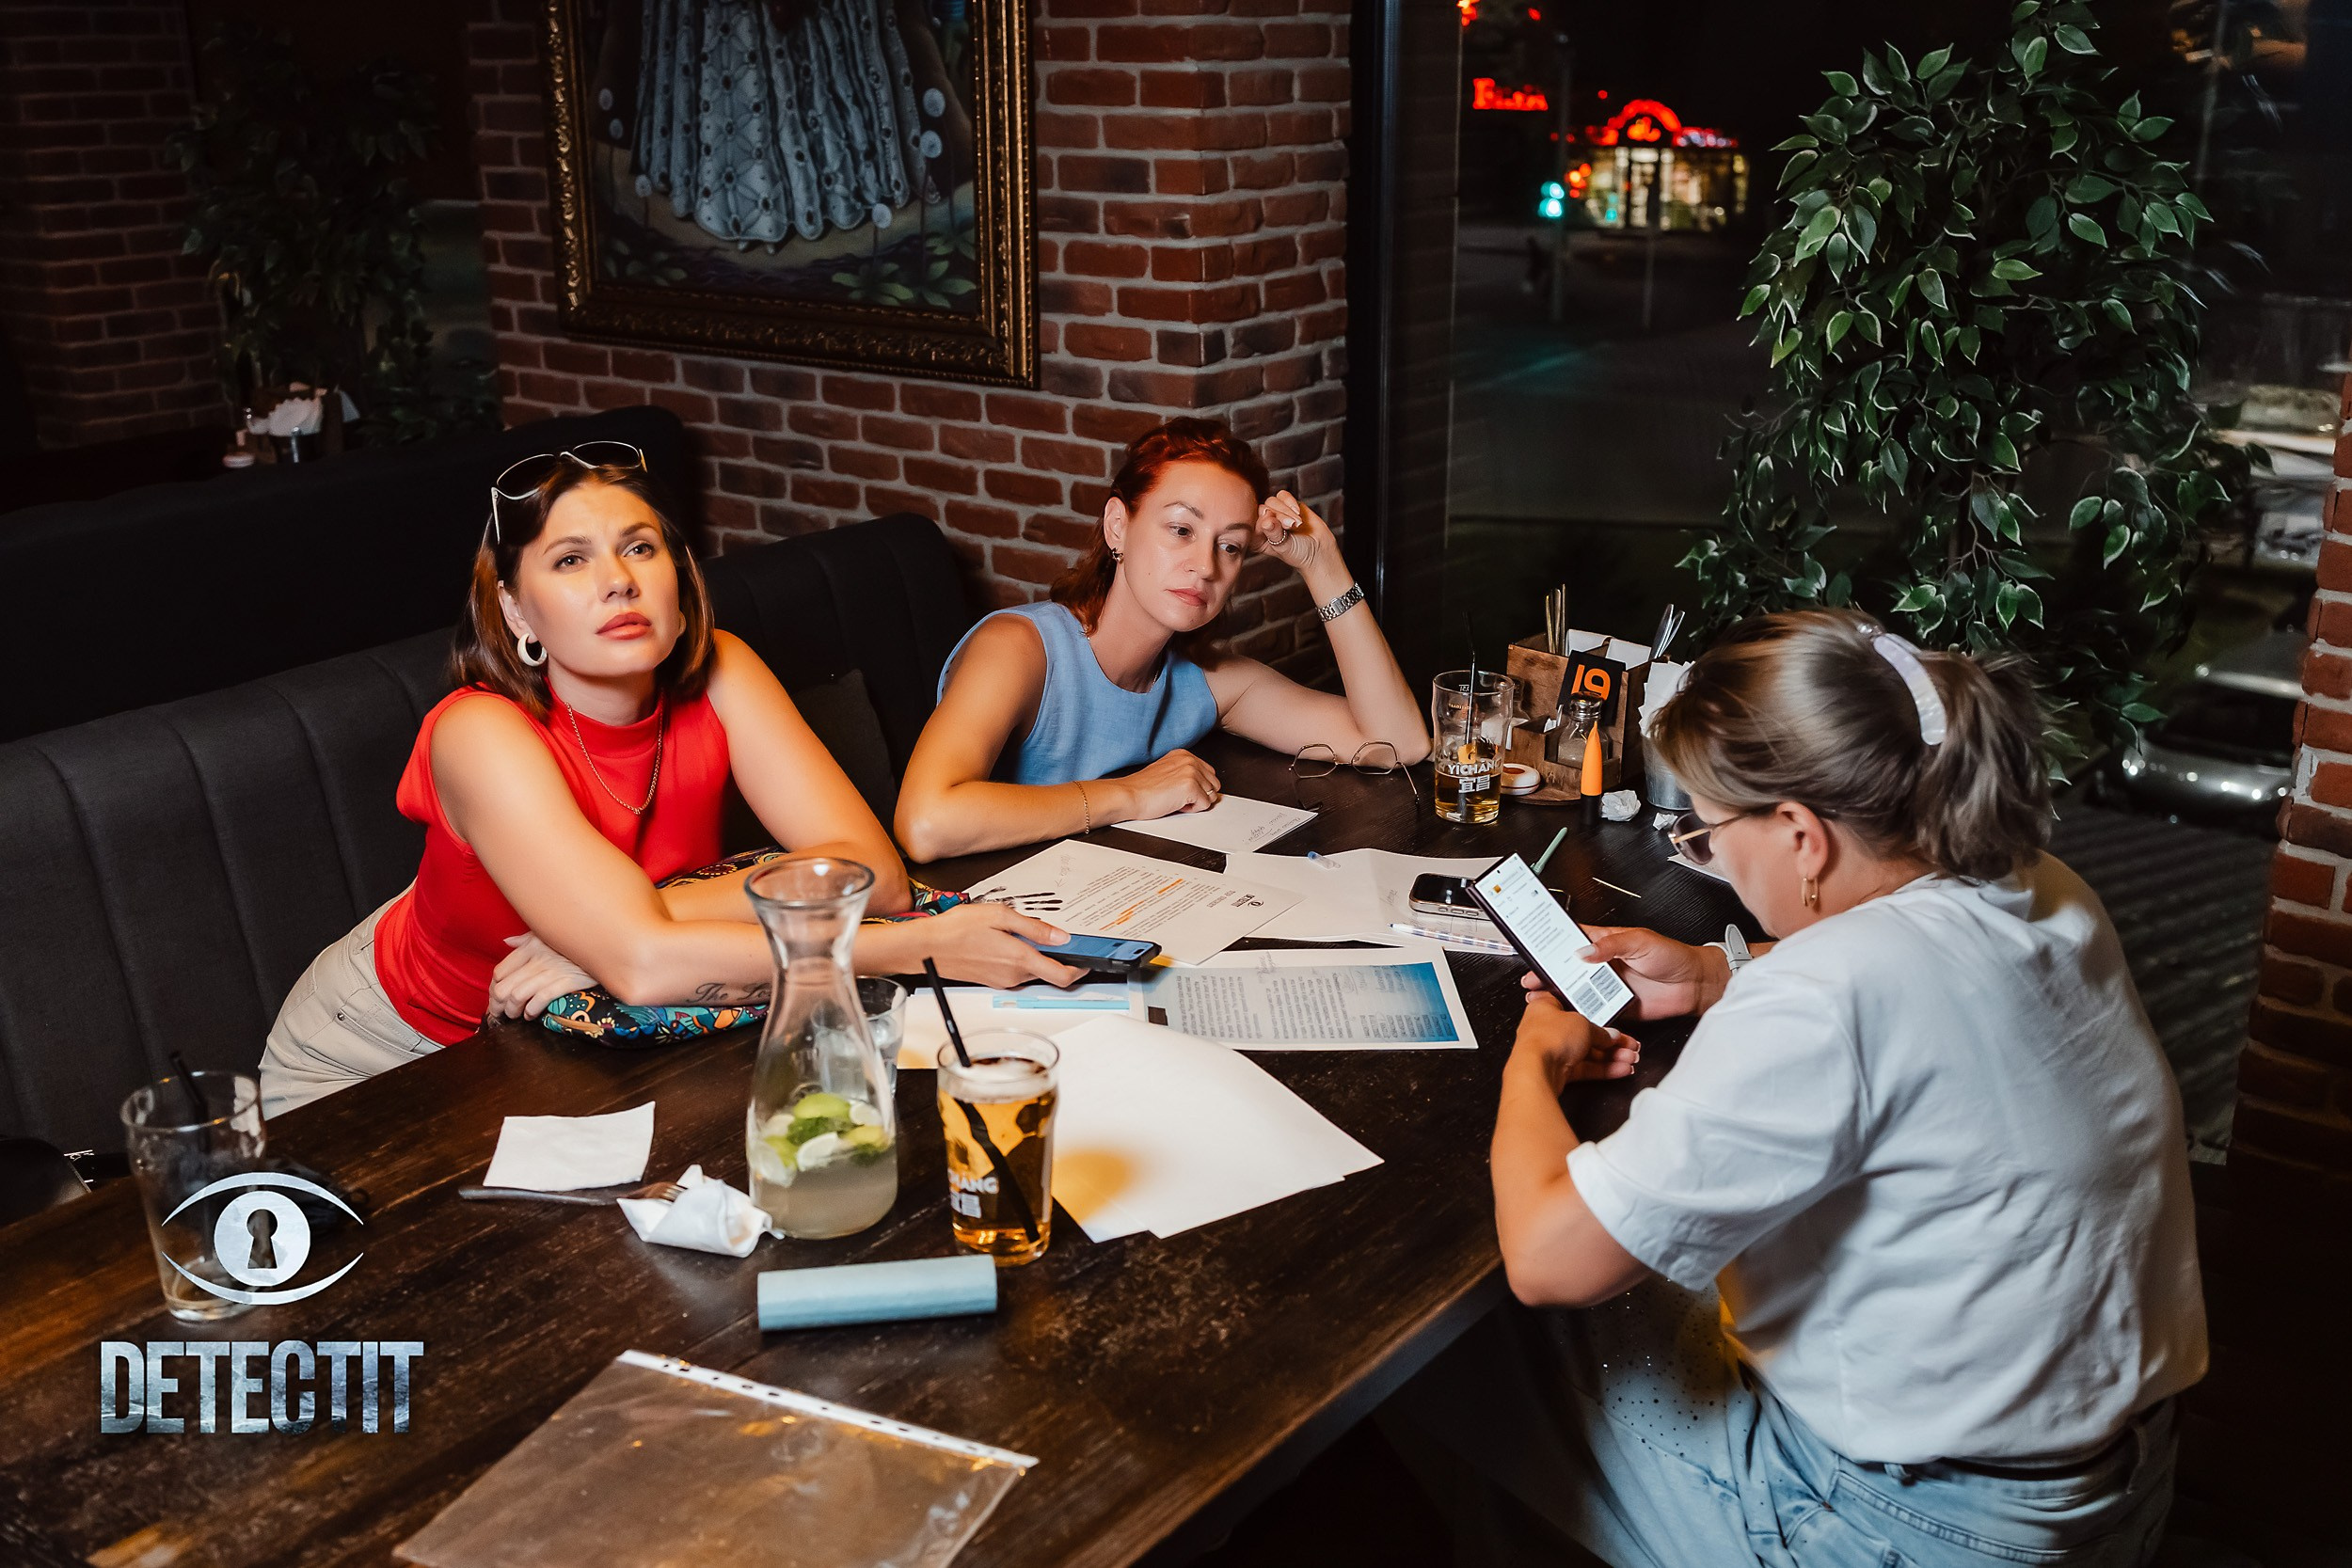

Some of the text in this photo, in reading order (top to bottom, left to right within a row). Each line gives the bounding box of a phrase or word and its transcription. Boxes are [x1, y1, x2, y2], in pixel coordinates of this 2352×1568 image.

[1570, 663, 1611, 701] 19
[1458, 774, 1491, 794] 宜昌
[685, 982, 728, 1004] The
